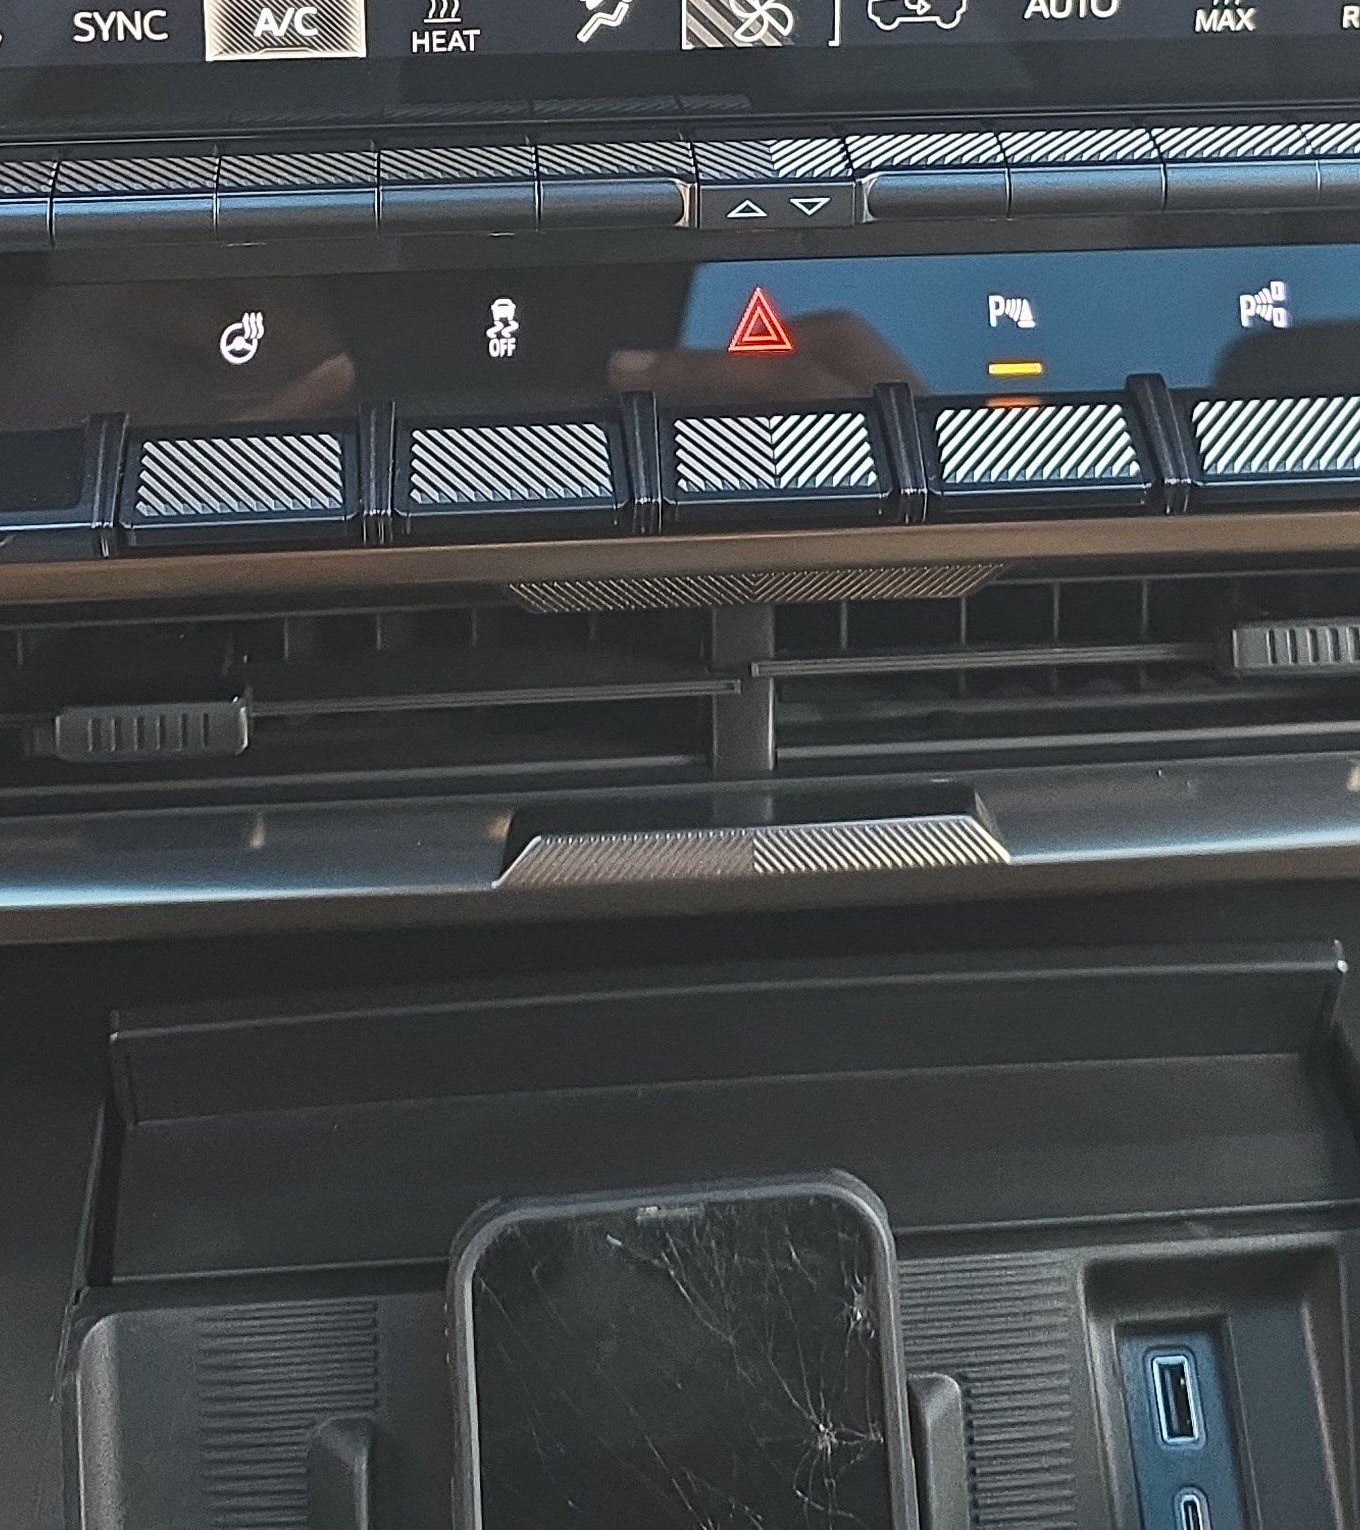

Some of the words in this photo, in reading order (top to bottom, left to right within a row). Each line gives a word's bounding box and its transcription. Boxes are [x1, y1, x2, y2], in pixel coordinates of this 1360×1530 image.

[73, 10, 169, 44] SYNC
[253, 6, 319, 38] A/C
[1194, 8, 1256, 32] MAX
[411, 29, 481, 53] HEAT
[489, 338, 517, 357] OFF
